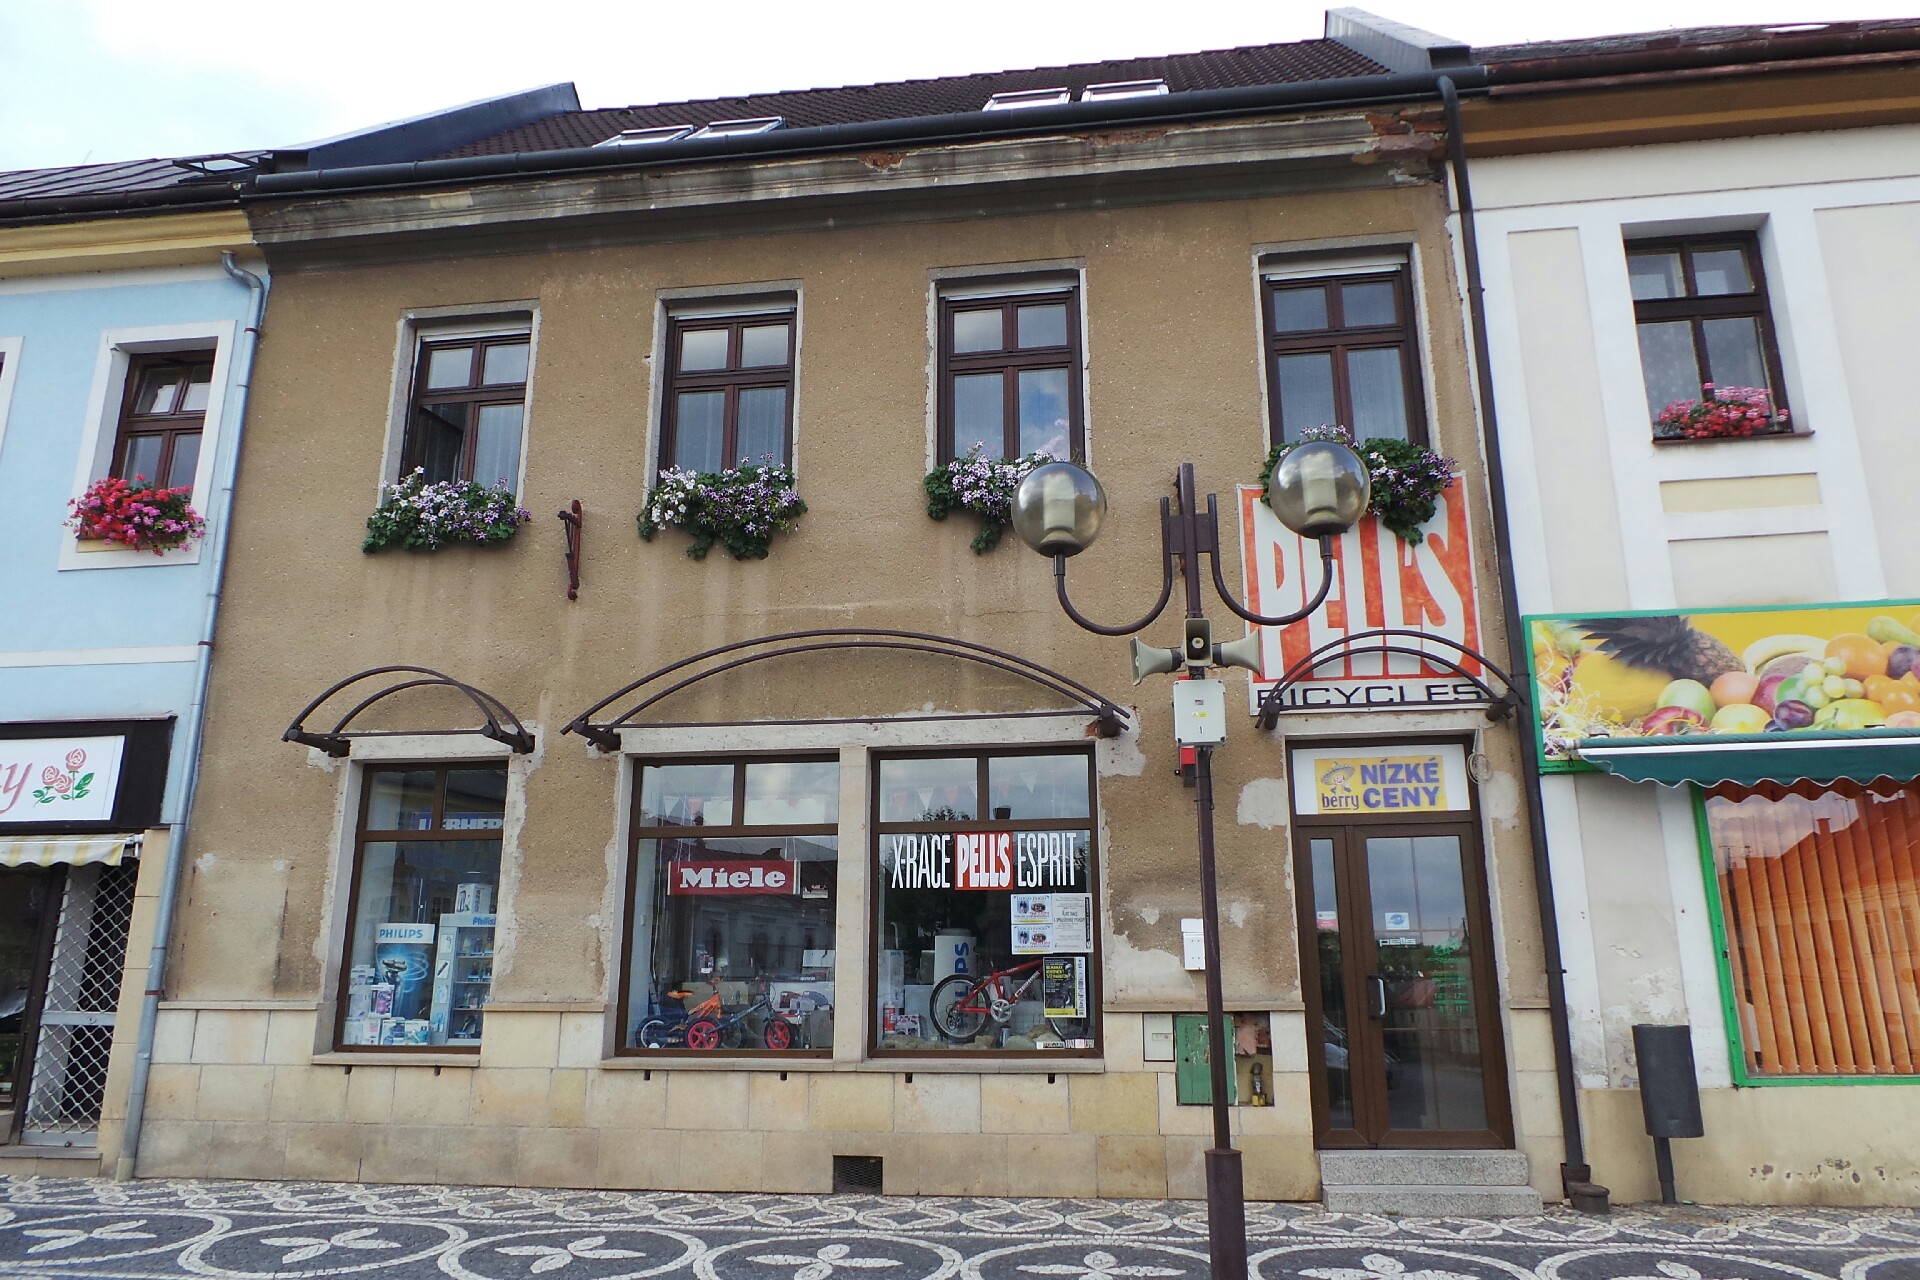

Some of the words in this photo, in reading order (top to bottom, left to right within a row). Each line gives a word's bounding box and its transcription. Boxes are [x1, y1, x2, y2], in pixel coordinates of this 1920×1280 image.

[1252, 487, 1467, 681] PELL'S
[1257, 684, 1482, 708] BICYCLES
[1360, 757, 1440, 785] NÍZKÉ
[0, 762, 33, 814] y
[1363, 786, 1440, 808] CENY
[1322, 792, 1359, 811] berry
[891, 834, 951, 889] X-RACE
[956, 833, 1011, 888] PELL'S
[1017, 832, 1077, 888] ESPRIT
[679, 867, 786, 889] Miele
[379, 928, 424, 939] PHILIPS
[1379, 937, 1417, 947] pells
